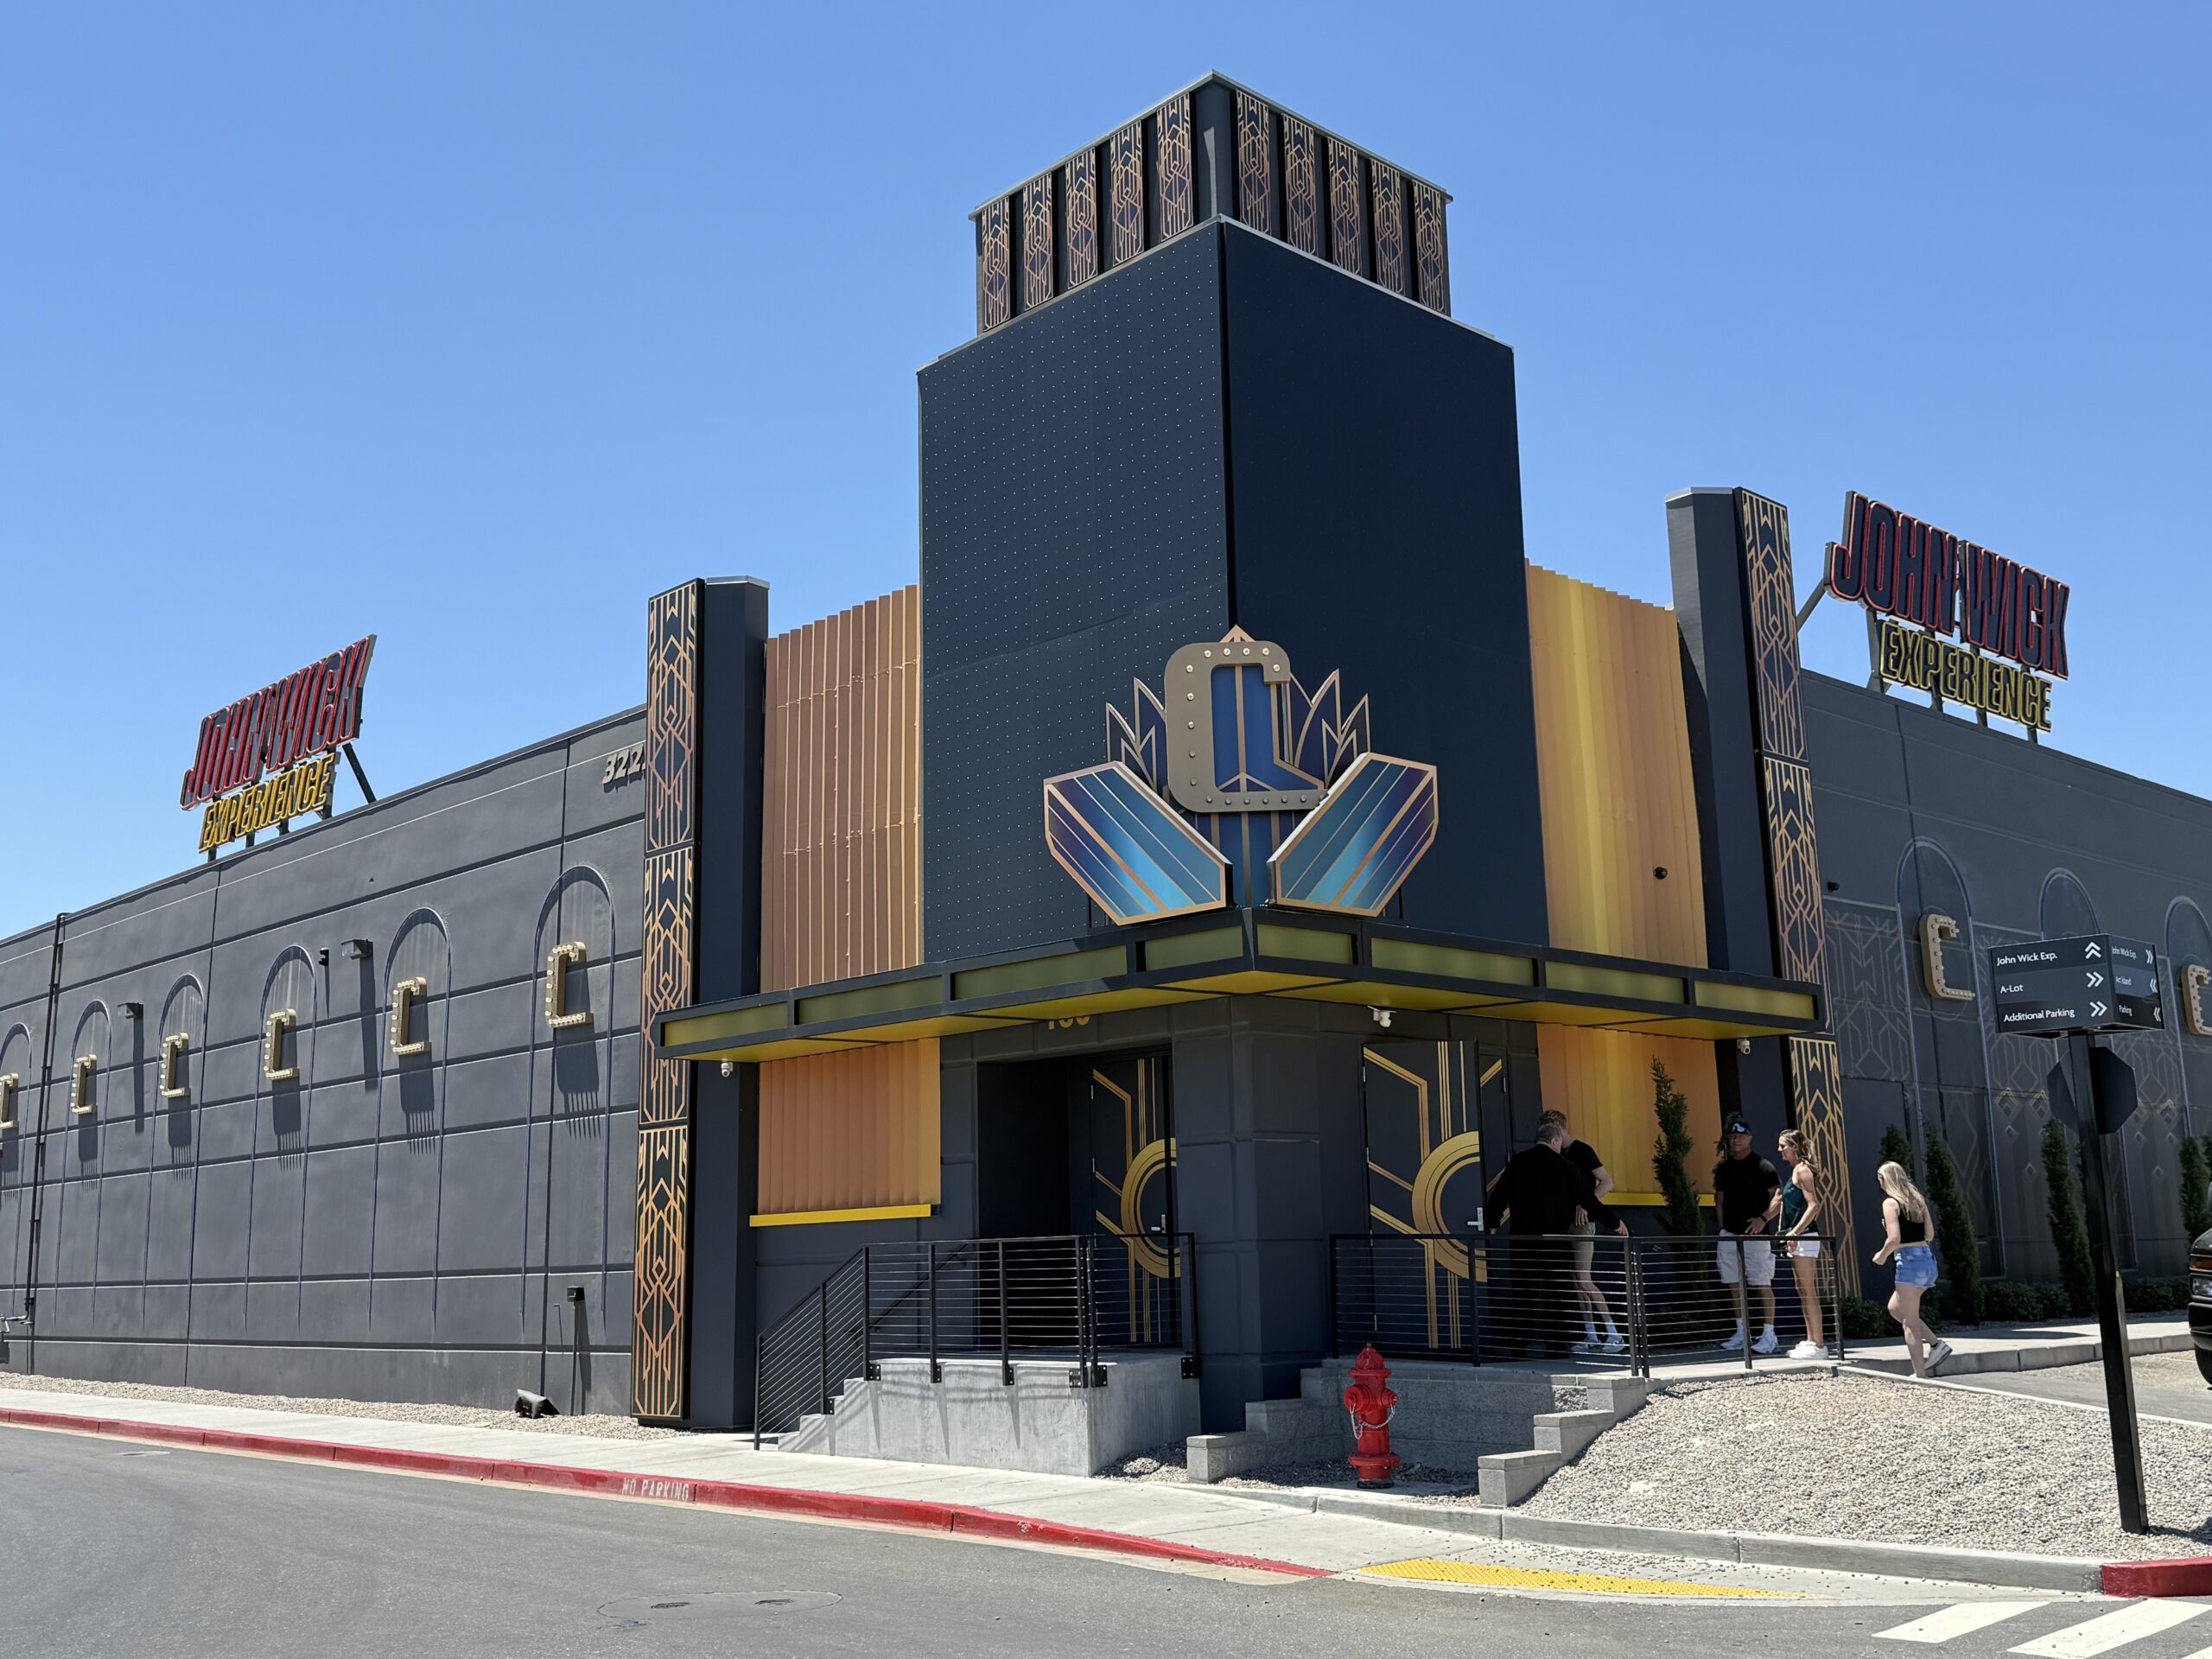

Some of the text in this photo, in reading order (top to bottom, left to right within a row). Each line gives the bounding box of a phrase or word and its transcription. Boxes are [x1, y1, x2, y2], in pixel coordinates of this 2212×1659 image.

[1825, 491, 2071, 681] JOHN WICK
[1878, 620, 2053, 732] EXPERIENCE
[180, 635, 373, 810] JOHN WICK
[601, 744, 646, 785] 322
[199, 752, 339, 854] EXPERIENCE
[1997, 951, 2058, 966] John Wick Exp.
[1999, 984, 2024, 994] A-Lot
[2004, 1008, 2075, 1022] Additional Parking
[622, 1477, 690, 1501] NO PARKING
